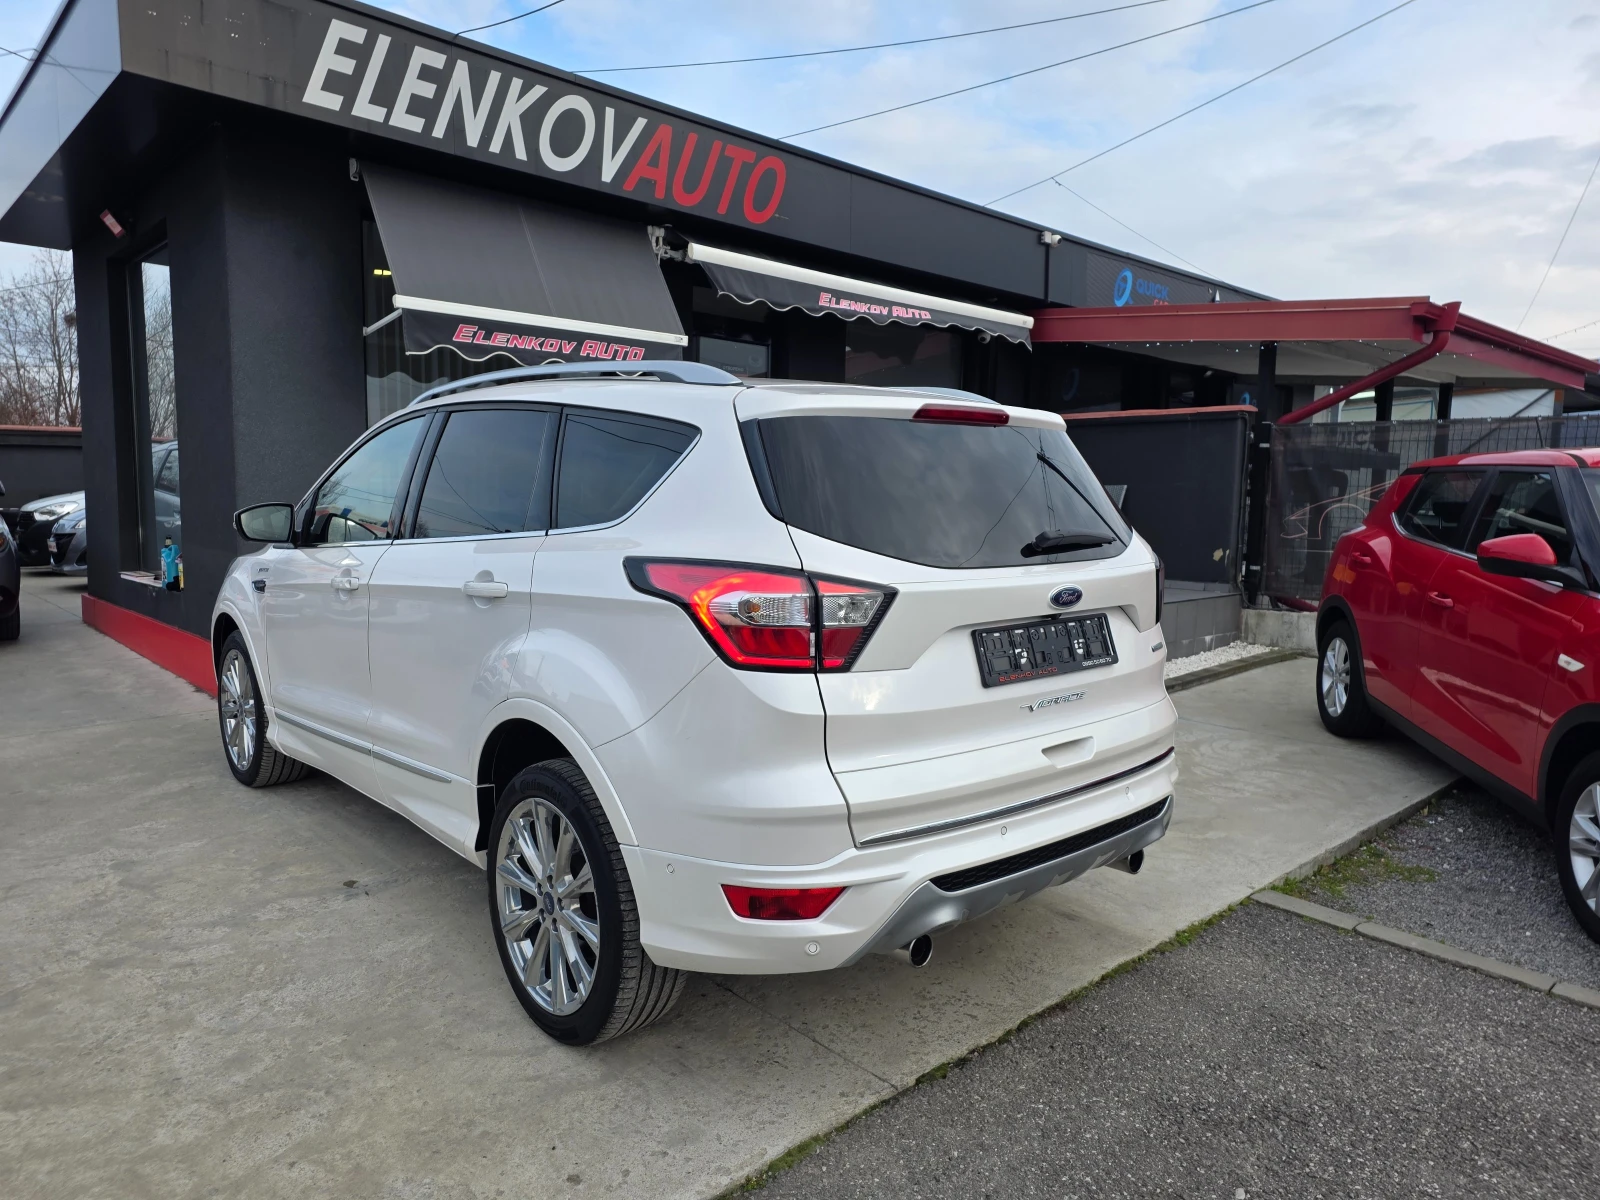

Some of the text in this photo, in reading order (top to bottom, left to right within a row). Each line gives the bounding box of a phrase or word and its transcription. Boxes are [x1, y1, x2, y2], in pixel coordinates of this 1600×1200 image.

[1136, 278, 1169, 299] QUICK
[818, 292, 932, 319] ELENKOV AUTO
[452, 323, 645, 361] ELENKOV AUTO
